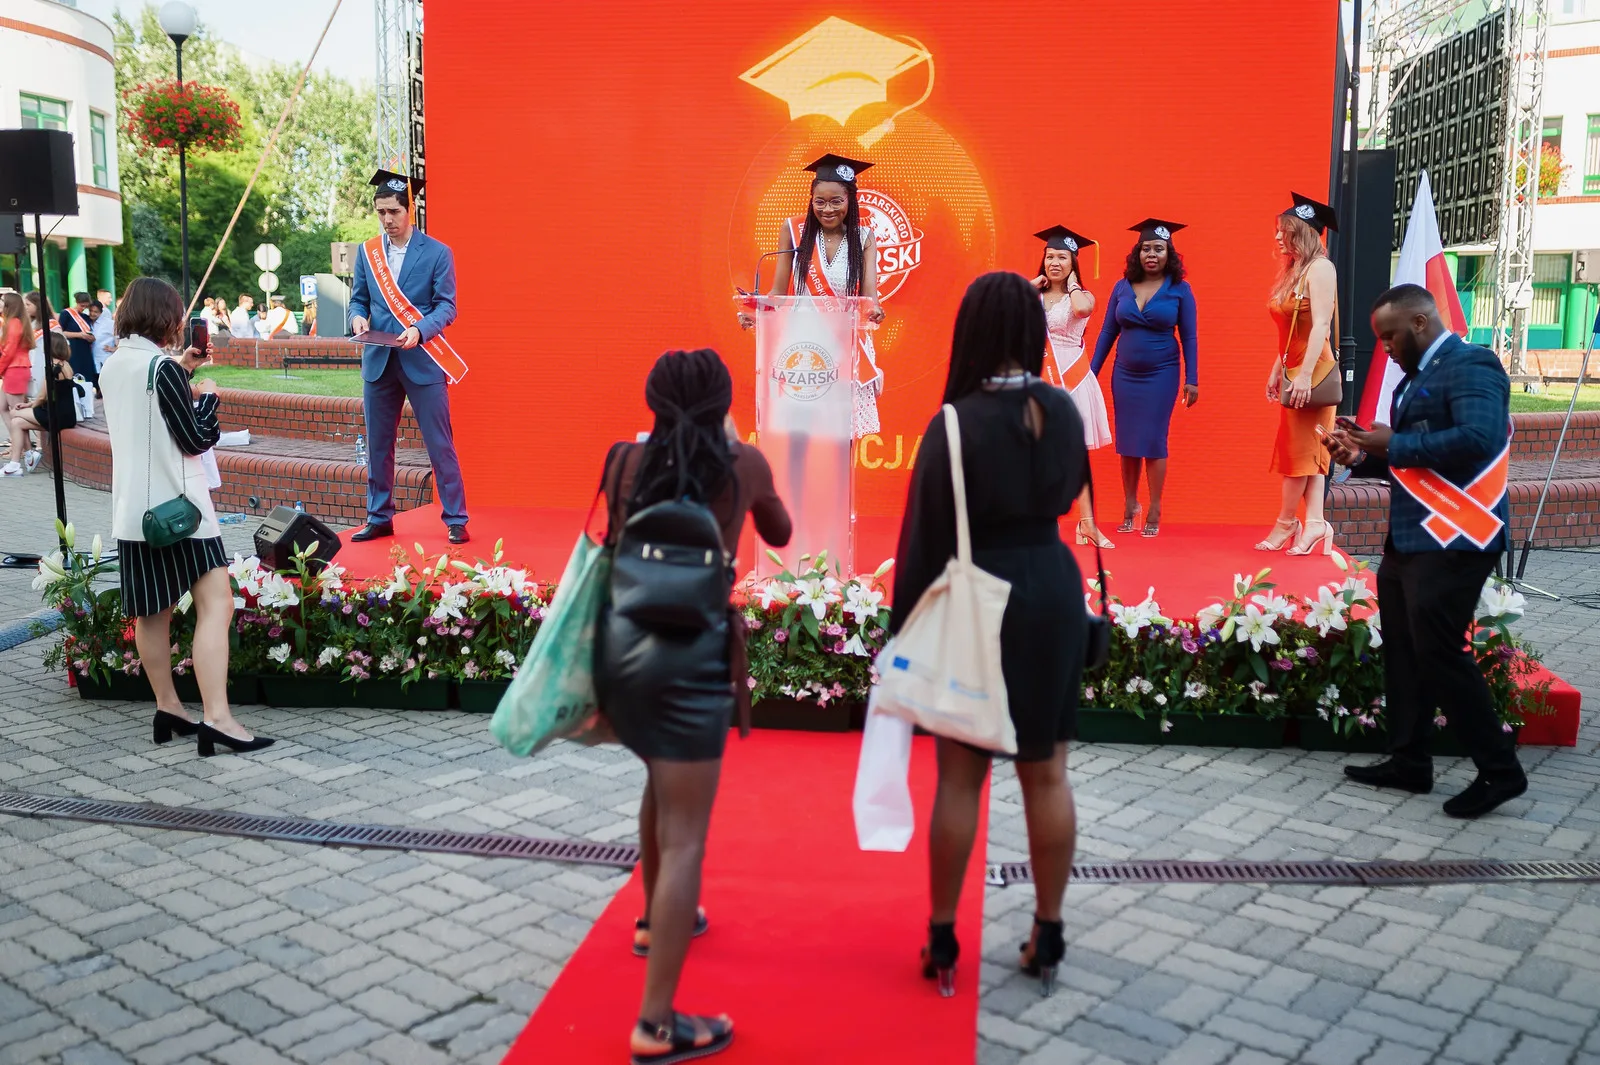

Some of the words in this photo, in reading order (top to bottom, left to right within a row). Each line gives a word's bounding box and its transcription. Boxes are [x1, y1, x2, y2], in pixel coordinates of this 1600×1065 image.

[858, 193, 909, 239] AZARSKIEGO
[371, 248, 388, 283] UCZELNIA
[876, 240, 921, 274] RSKI
[779, 346, 800, 367] UCZELNIA
[772, 368, 839, 385] ŁAZARSKI
